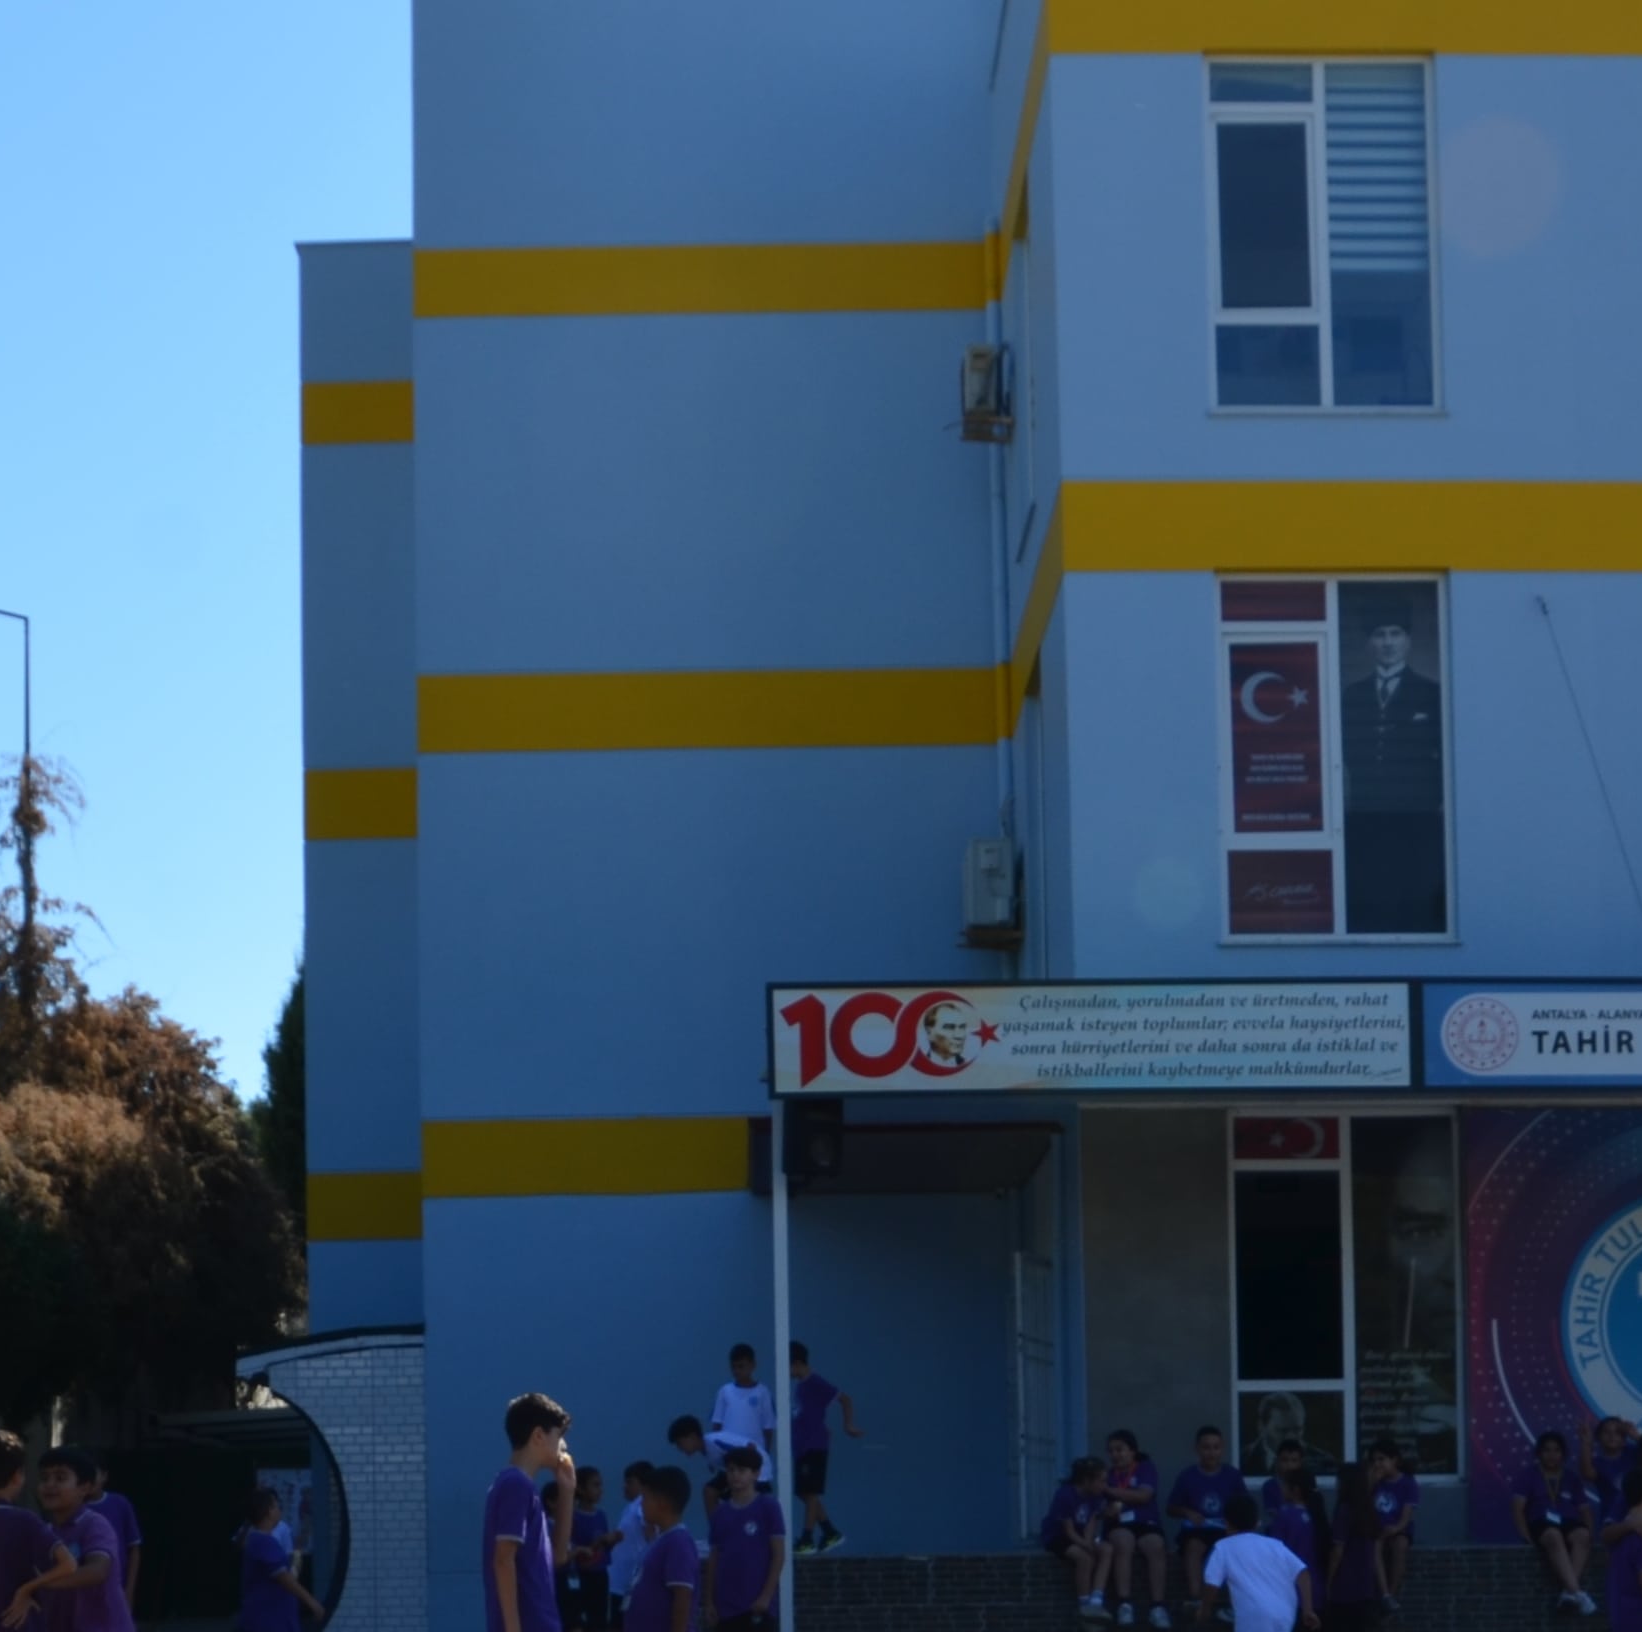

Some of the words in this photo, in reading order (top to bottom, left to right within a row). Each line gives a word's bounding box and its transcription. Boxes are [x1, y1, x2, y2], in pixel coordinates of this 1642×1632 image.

[1020, 994, 1120, 1012] Çalışmadan,
[1127, 993, 1225, 1012] yorulmadan
[1230, 996, 1247, 1007] ve
[1253, 992, 1338, 1008] üretmeden,
[1344, 992, 1389, 1007] rahat
[1532, 1009, 1587, 1020] ANTALYA
[1001, 1017, 1074, 1036] yaşamak
[1081, 1016, 1137, 1036] isteyen
[1233, 1015, 1284, 1029] evvela
[1290, 1015, 1405, 1034] haysiyetlerini,
[1011, 1043, 1055, 1055] sonra
[1061, 1040, 1169, 1058] hürriyetlerini
[1174, 1042, 1193, 1053] ve
[1197, 1038, 1237, 1053] daha
[1242, 1041, 1287, 1052] sonra
[1292, 1037, 1312, 1052] da
[1317, 1037, 1375, 1052] istiklal
[1381, 1041, 1398, 1052] ve
[1531, 1025, 1634, 1053] TAHİR
[1037, 1062, 1143, 1077] istikballerini
[1148, 1061, 1245, 1081] kaybetmeye
